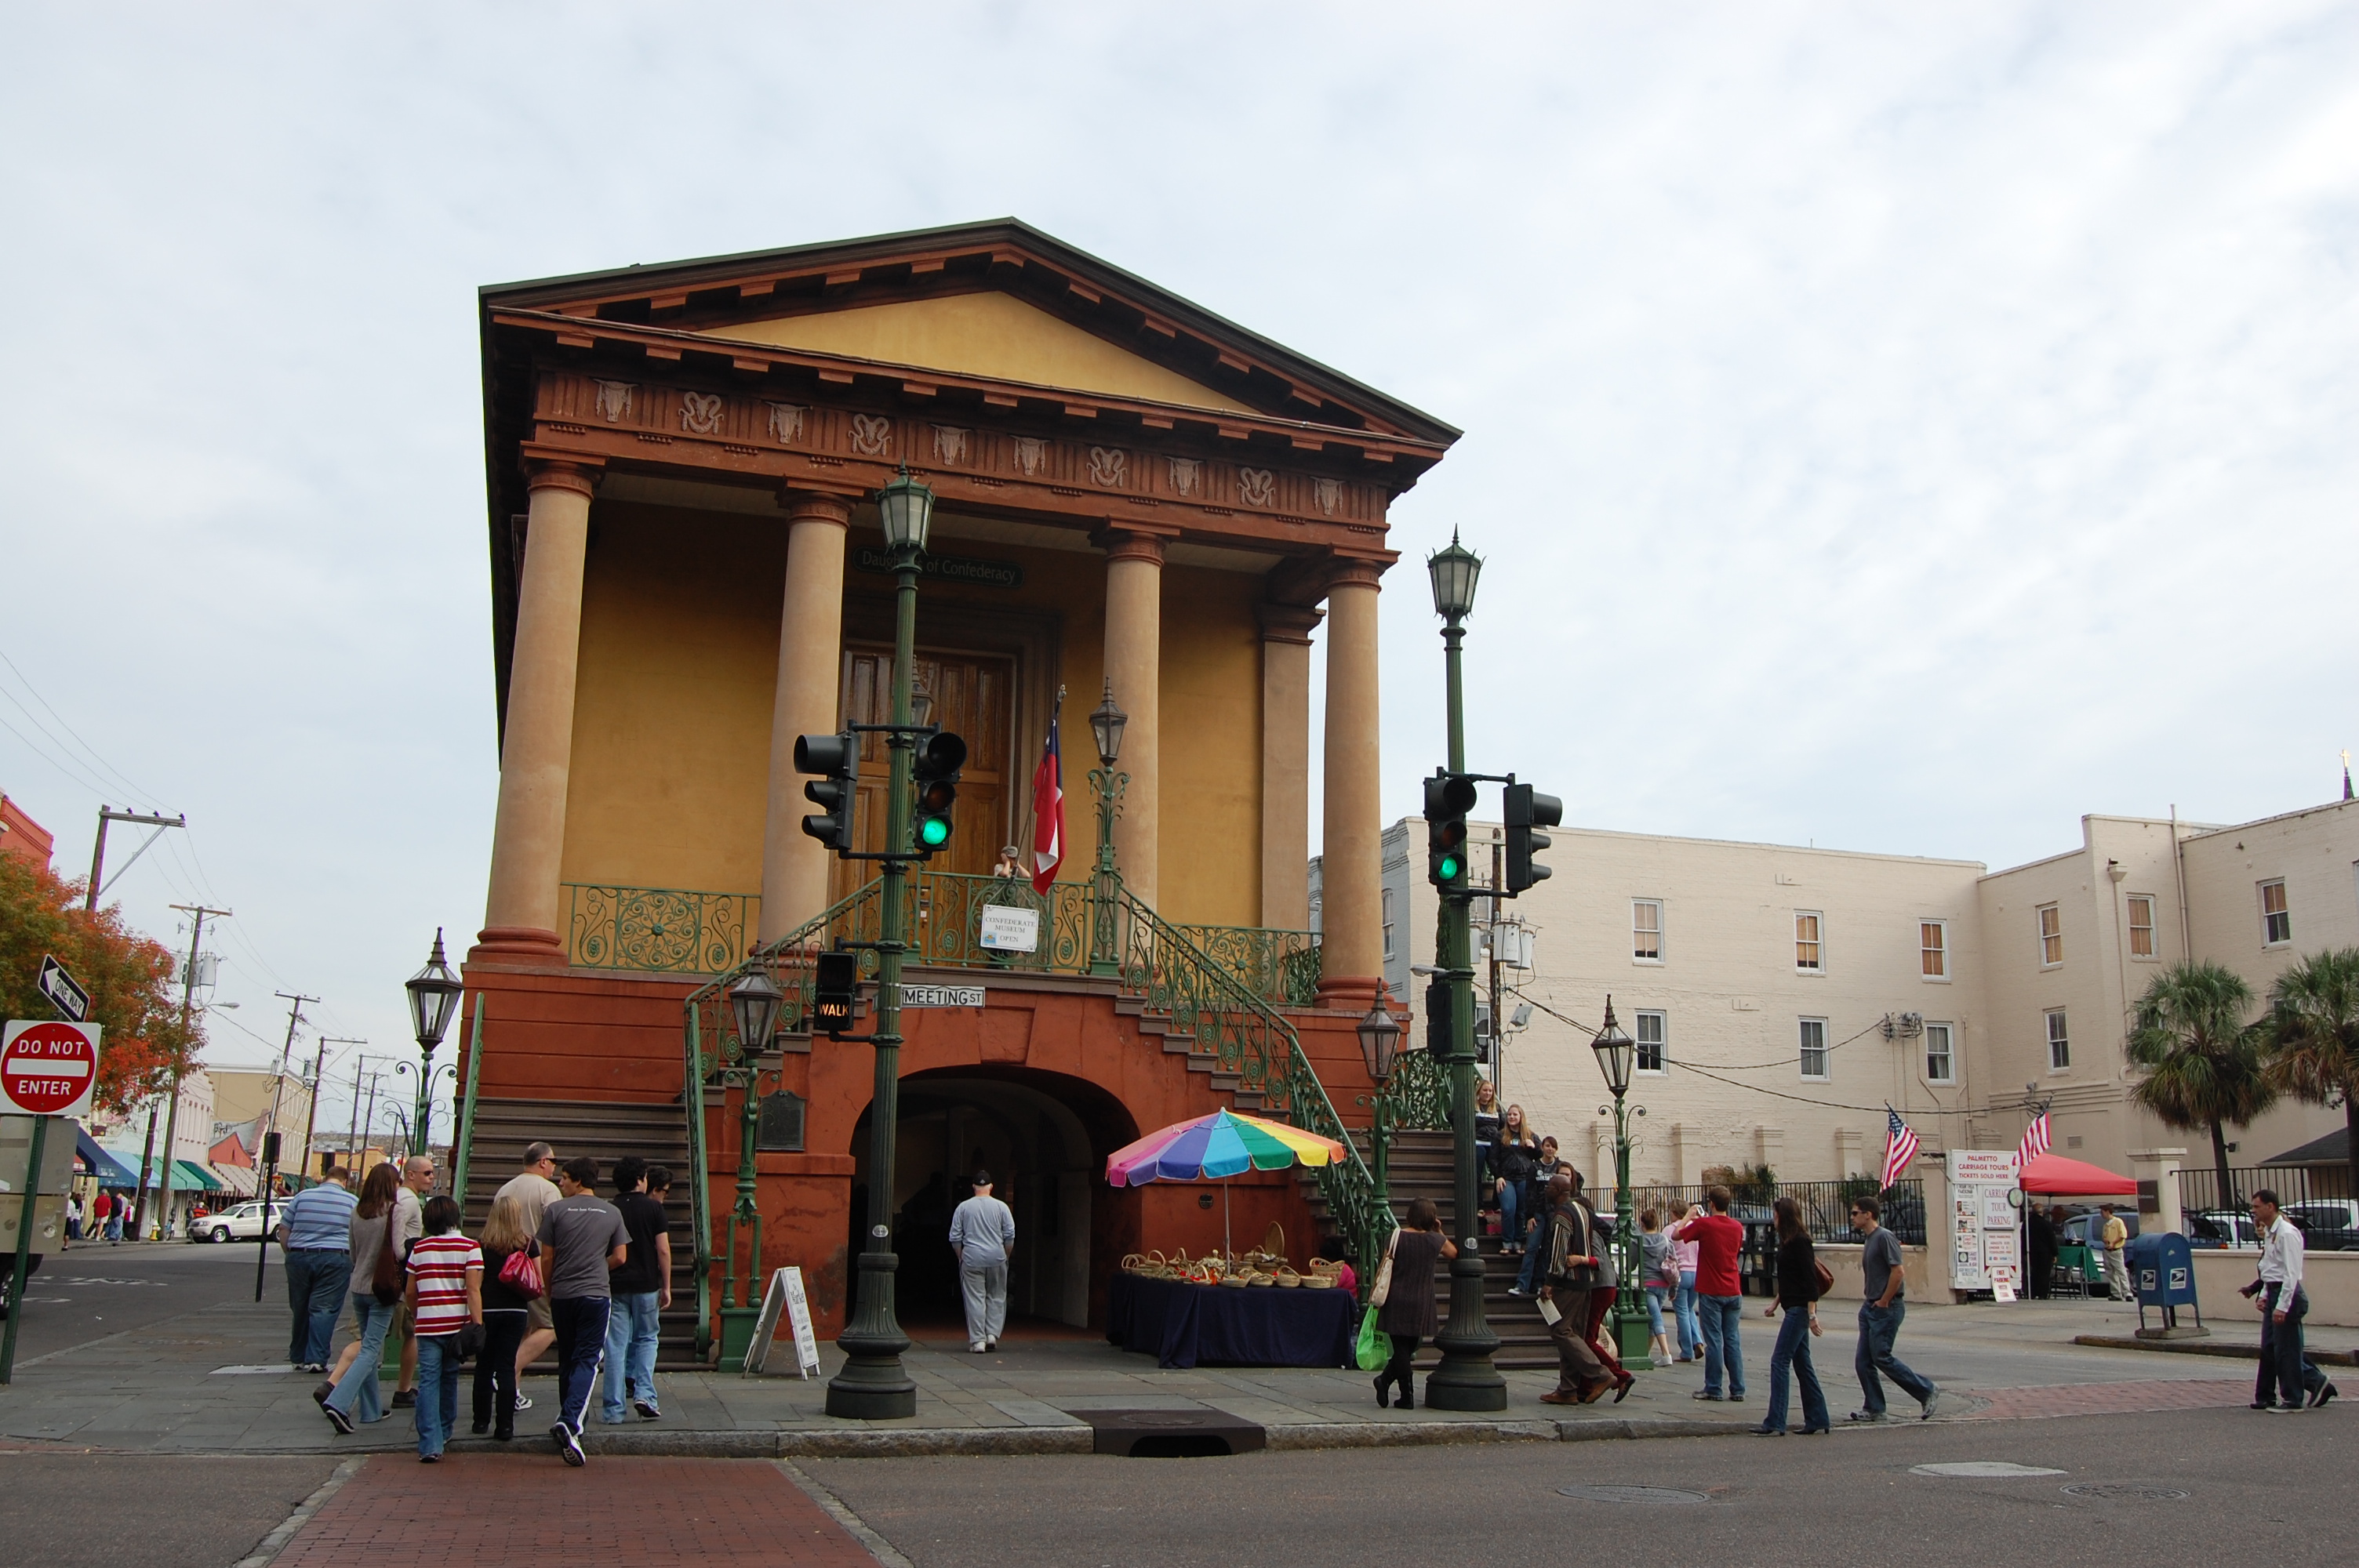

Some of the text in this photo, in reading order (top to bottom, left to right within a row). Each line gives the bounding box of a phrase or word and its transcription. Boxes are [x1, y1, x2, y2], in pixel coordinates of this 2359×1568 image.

[926, 559, 939, 572] of
[942, 560, 1016, 585] Confederacy
[985, 916, 1035, 927] CONFEDERATE
[994, 924, 1026, 934] MUSEUM
[55, 978, 83, 1014] ONE WAY
[904, 989, 982, 1005] MEETING ST
[819, 1004, 849, 1017] WALK
[18, 1039, 85, 1055] DO NOT
[18, 1080, 71, 1095] ENTER
[1984, 1189, 2009, 1198] CARRIAG
[1991, 1202, 2007, 1212] TOUR
[1986, 1215, 2011, 1225] PARKING
